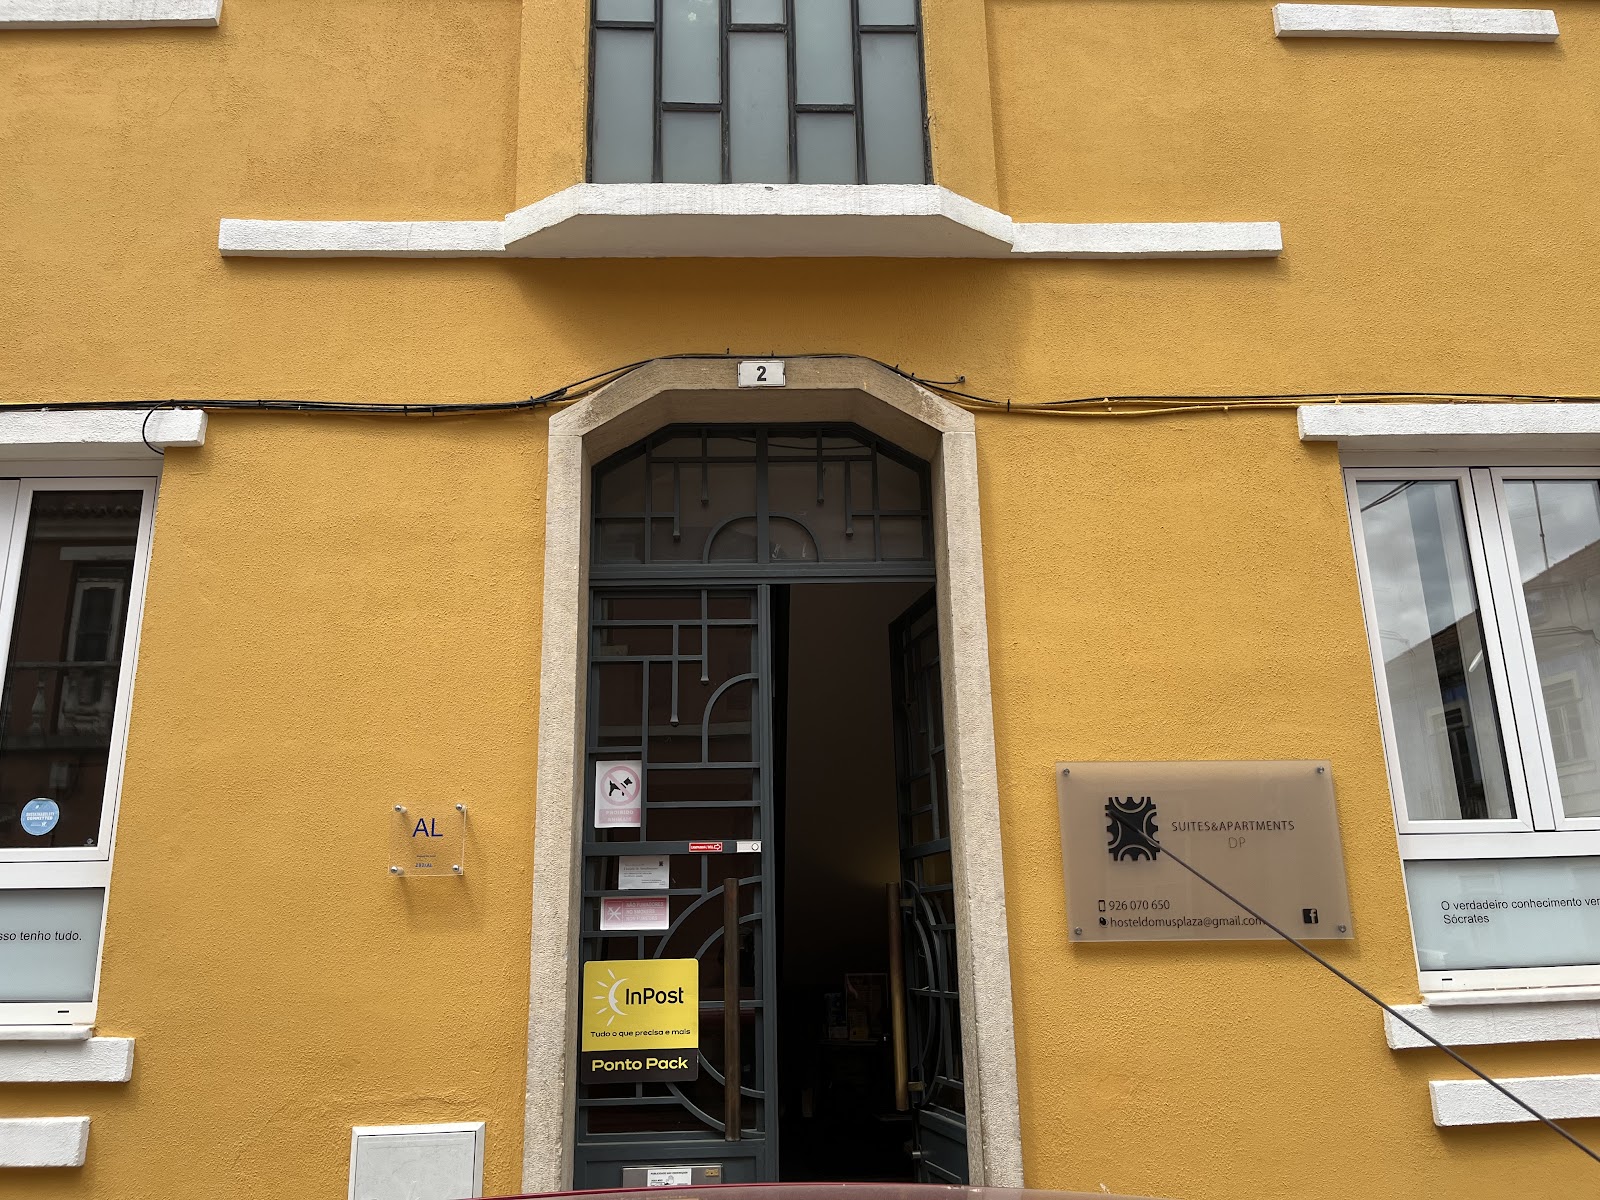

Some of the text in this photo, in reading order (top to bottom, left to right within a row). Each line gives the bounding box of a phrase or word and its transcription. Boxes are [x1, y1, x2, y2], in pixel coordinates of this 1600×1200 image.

[757, 365, 767, 382] 2
[412, 818, 443, 837] AL
[1171, 820, 1295, 832] SUITES&APARTMENTS
[1228, 837, 1246, 849] DP
[1108, 899, 1171, 911] 926 070 650
[1440, 900, 1450, 911] O
[1453, 899, 1508, 910] verdadeiro
[1511, 897, 1582, 909] conhecimento
[1443, 914, 1490, 924] Sócrates
[20, 930, 51, 941] tenho
[55, 930, 82, 941] tudo.
[625, 986, 684, 1005] InPost
[634, 1029, 664, 1037] precisa
[592, 1057, 689, 1072] Ponto Pack
